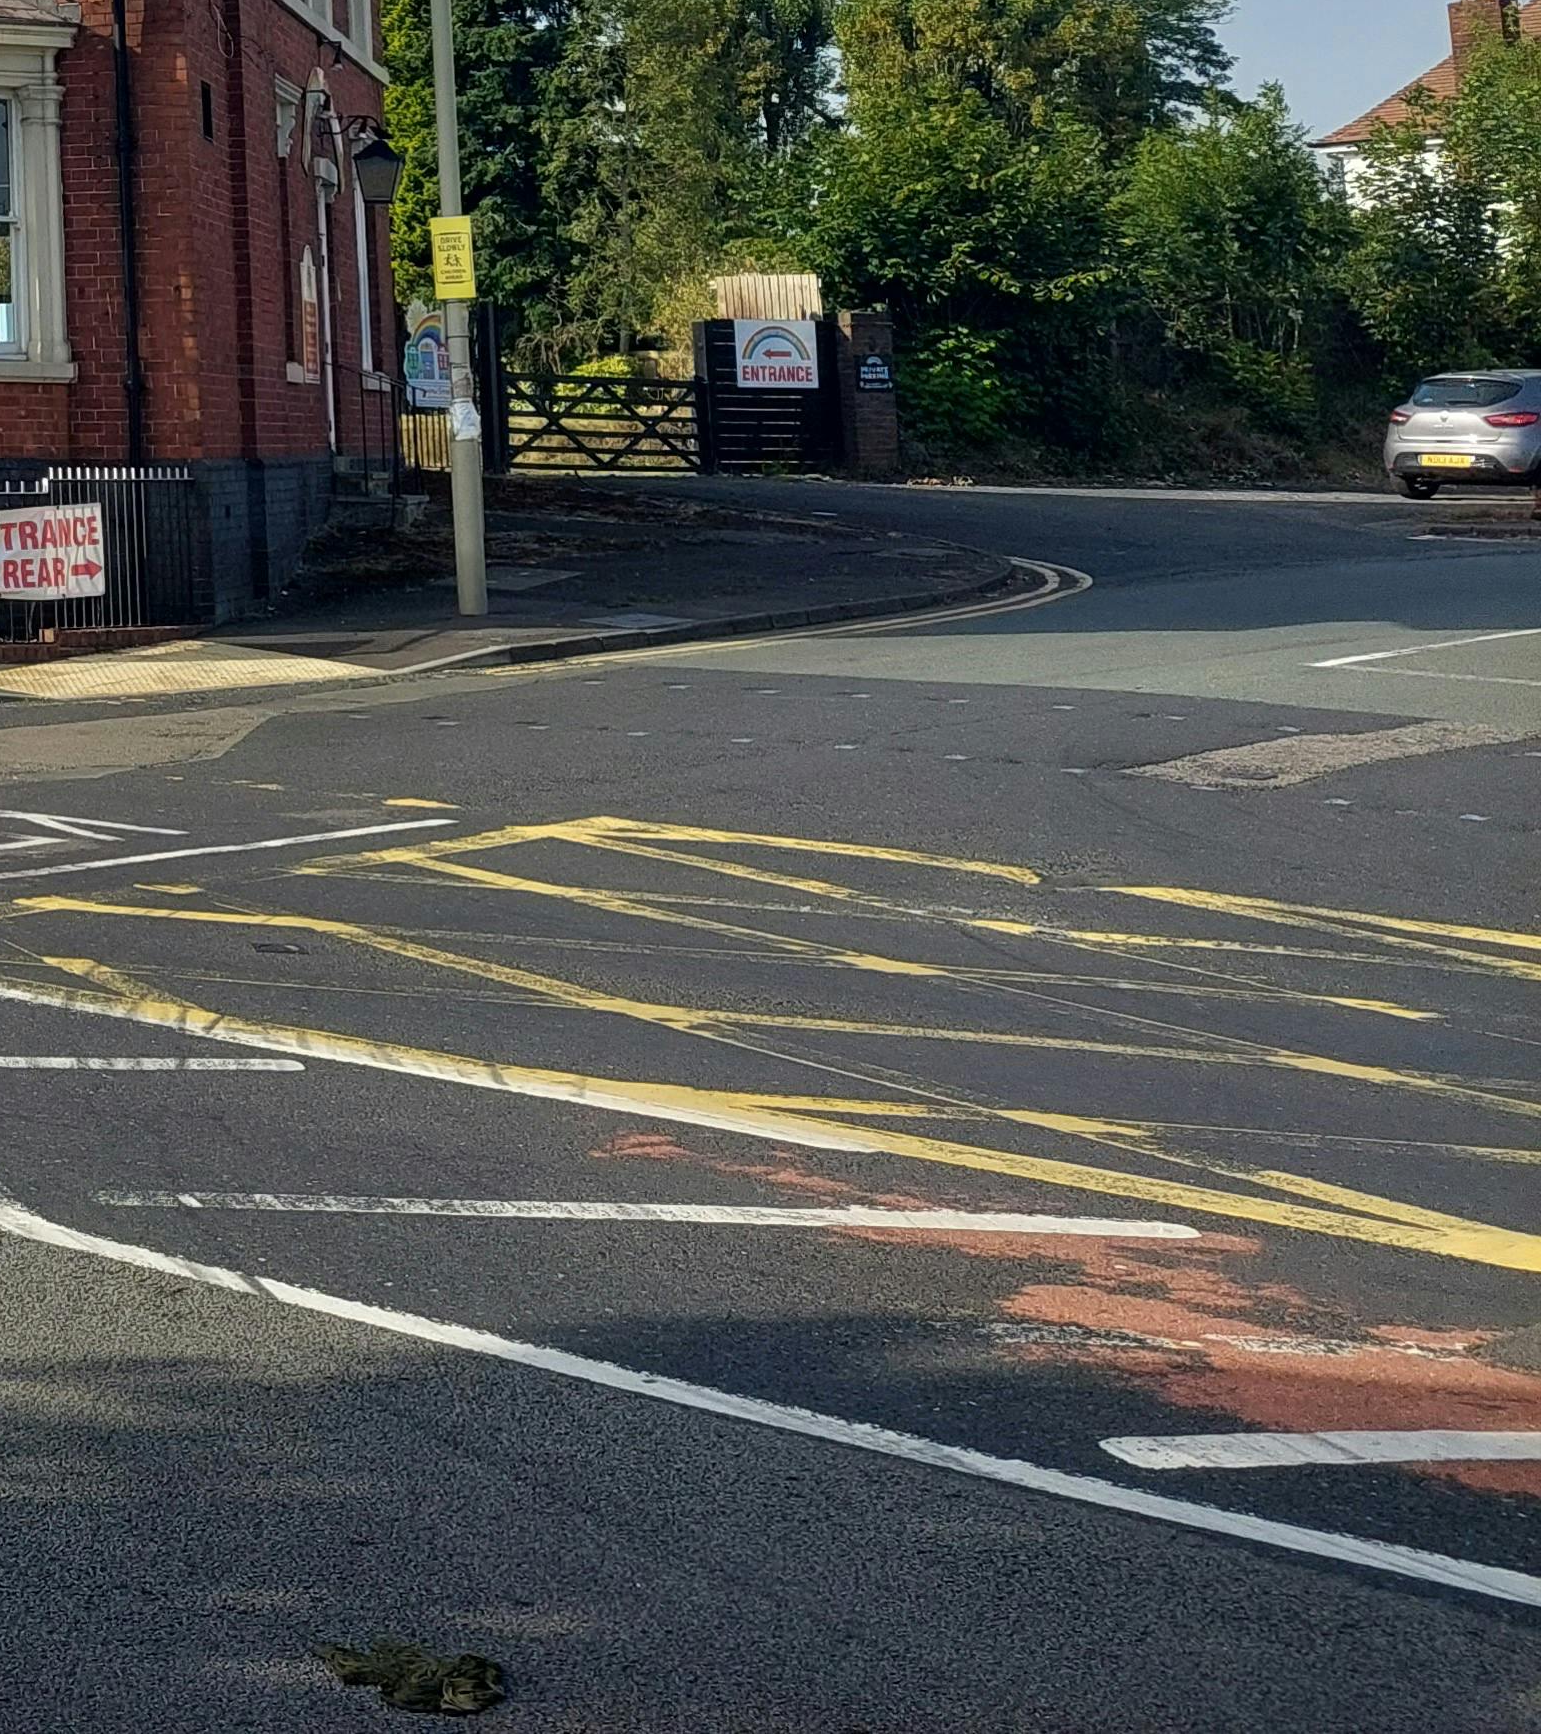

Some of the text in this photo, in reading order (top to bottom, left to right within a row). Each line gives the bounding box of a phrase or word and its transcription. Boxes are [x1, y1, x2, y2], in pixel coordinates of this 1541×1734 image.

[440, 236, 462, 244] DRIVE
[437, 244, 465, 252] SLOWLY
[742, 365, 813, 382] ENTRANCE
[3, 557, 66, 589] REAR
